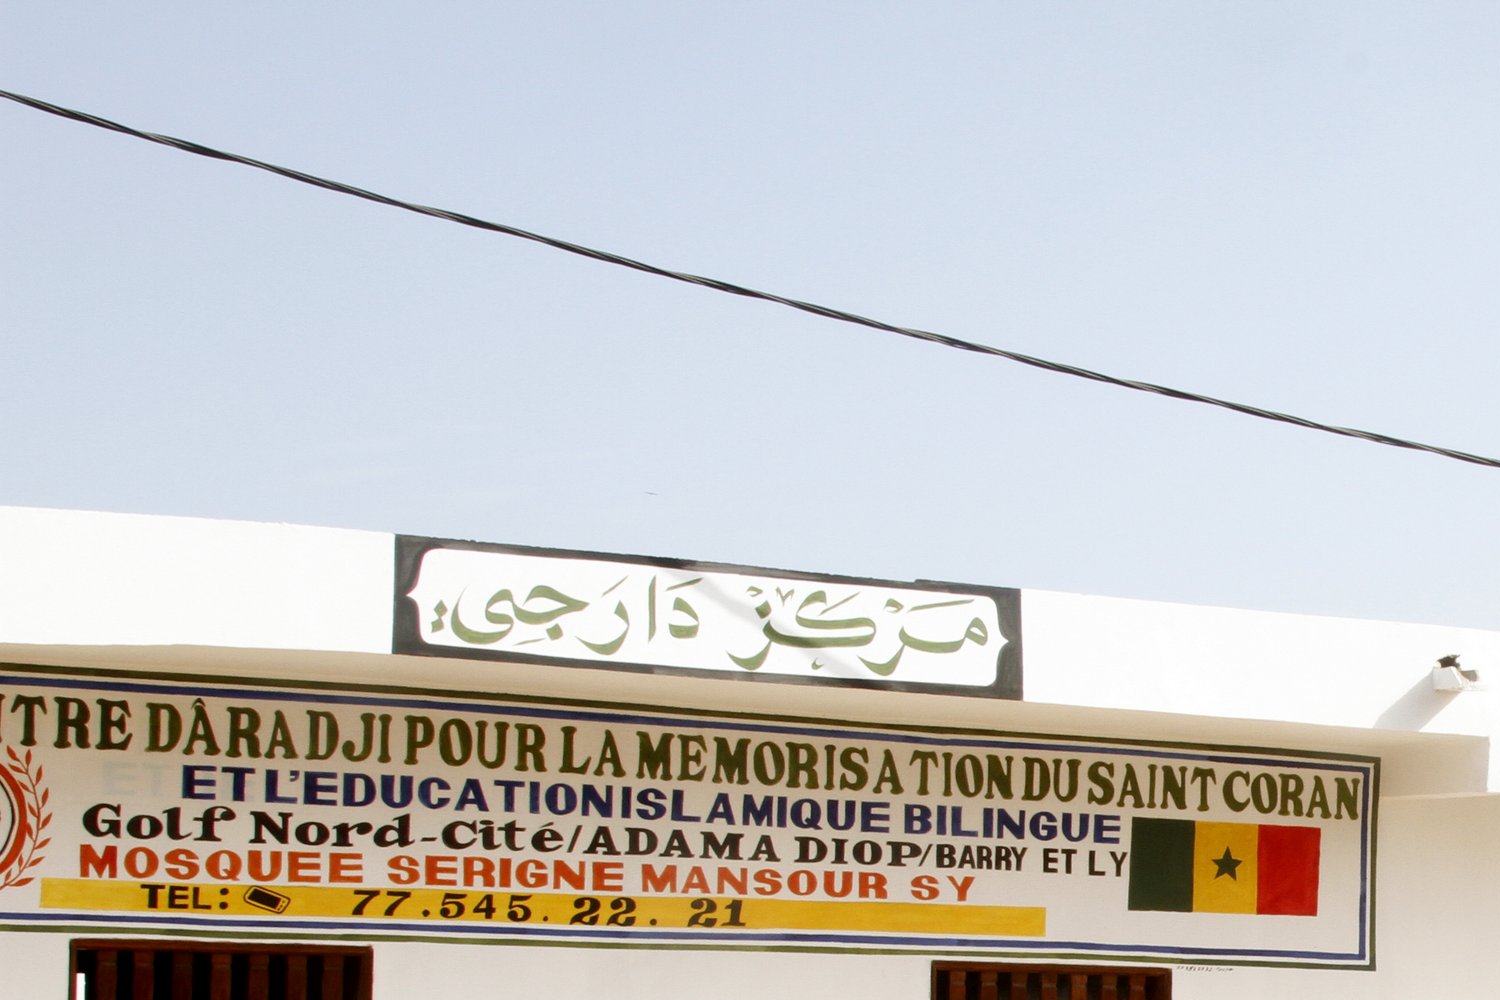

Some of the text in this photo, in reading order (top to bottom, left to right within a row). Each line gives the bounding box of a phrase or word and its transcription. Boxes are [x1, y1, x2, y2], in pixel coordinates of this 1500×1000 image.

[0, 693, 1361, 821] TRE DÂRADJI POUR LA MEMORISATION DU SAINT CORAN
[82, 802, 237, 842] Golf
[1042, 847, 1078, 875] ET
[1087, 850, 1128, 877] LY
[182, 764, 256, 802] ET
[620, 786, 891, 834] ISLAMIQUE
[903, 803, 1121, 845] BILINGUE
[79, 843, 976, 903] MOSQUEE SERIGNE MANSOUR SY
[140, 883, 230, 911] TEL:
